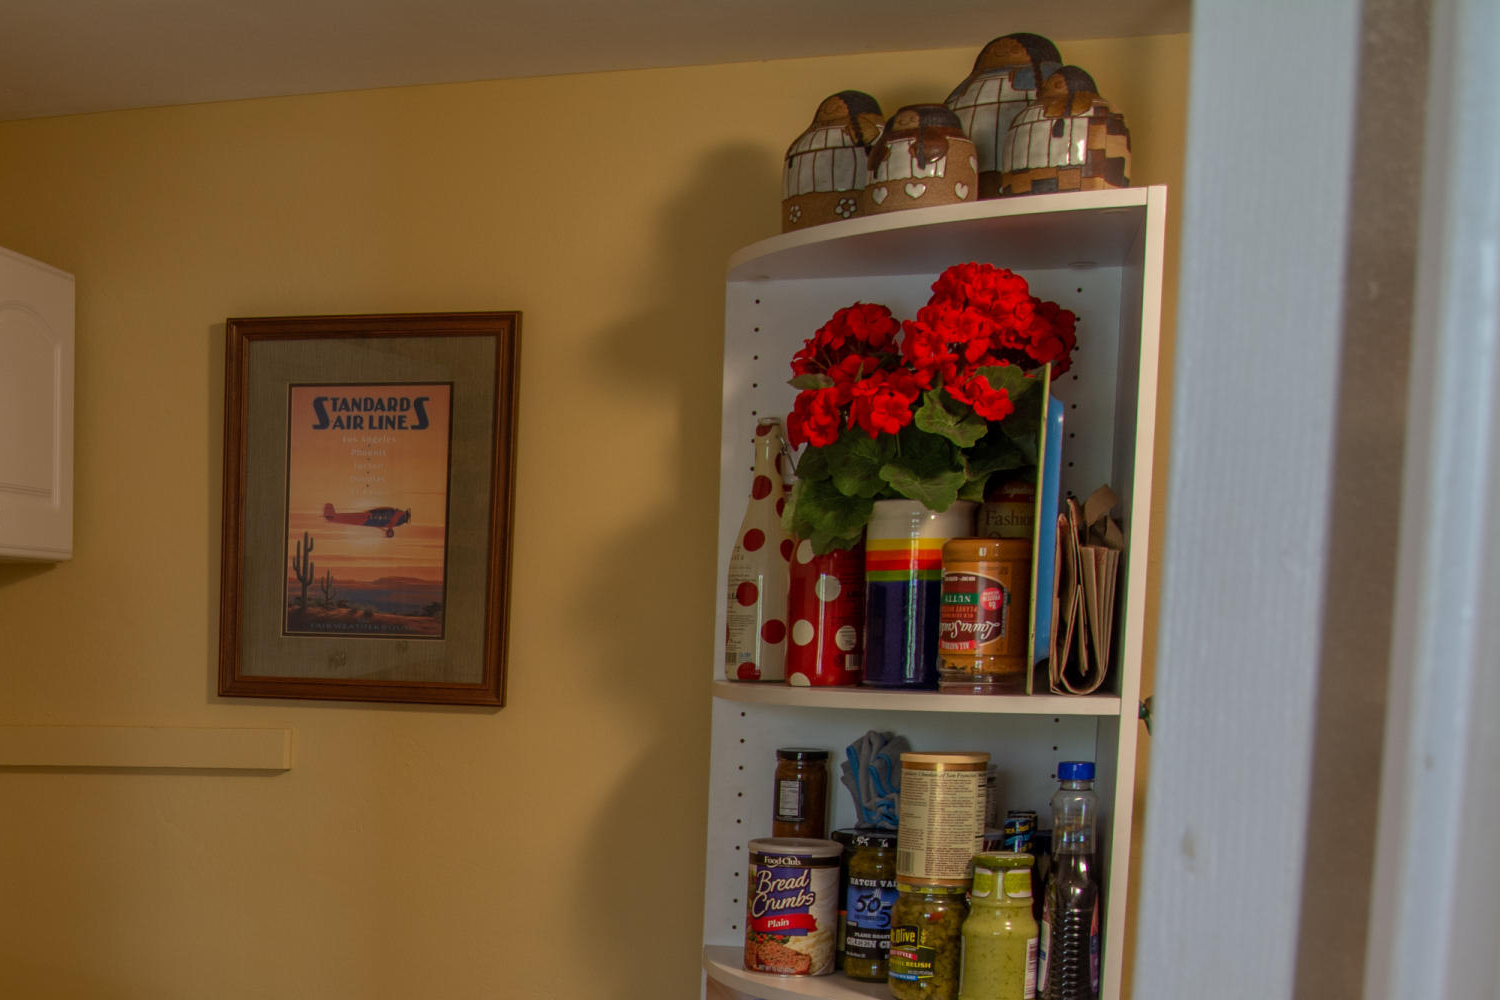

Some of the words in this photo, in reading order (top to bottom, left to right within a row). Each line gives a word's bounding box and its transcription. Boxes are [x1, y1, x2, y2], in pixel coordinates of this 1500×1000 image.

[332, 415, 364, 430] AIR
[961, 621, 1000, 640] Laura
[756, 869, 809, 894] Bread
[850, 878, 877, 887] HATCH
[752, 889, 816, 917] Crumbs
[767, 918, 789, 928] Plain
[846, 937, 877, 949] GREEN
[895, 928, 916, 943] Olive
